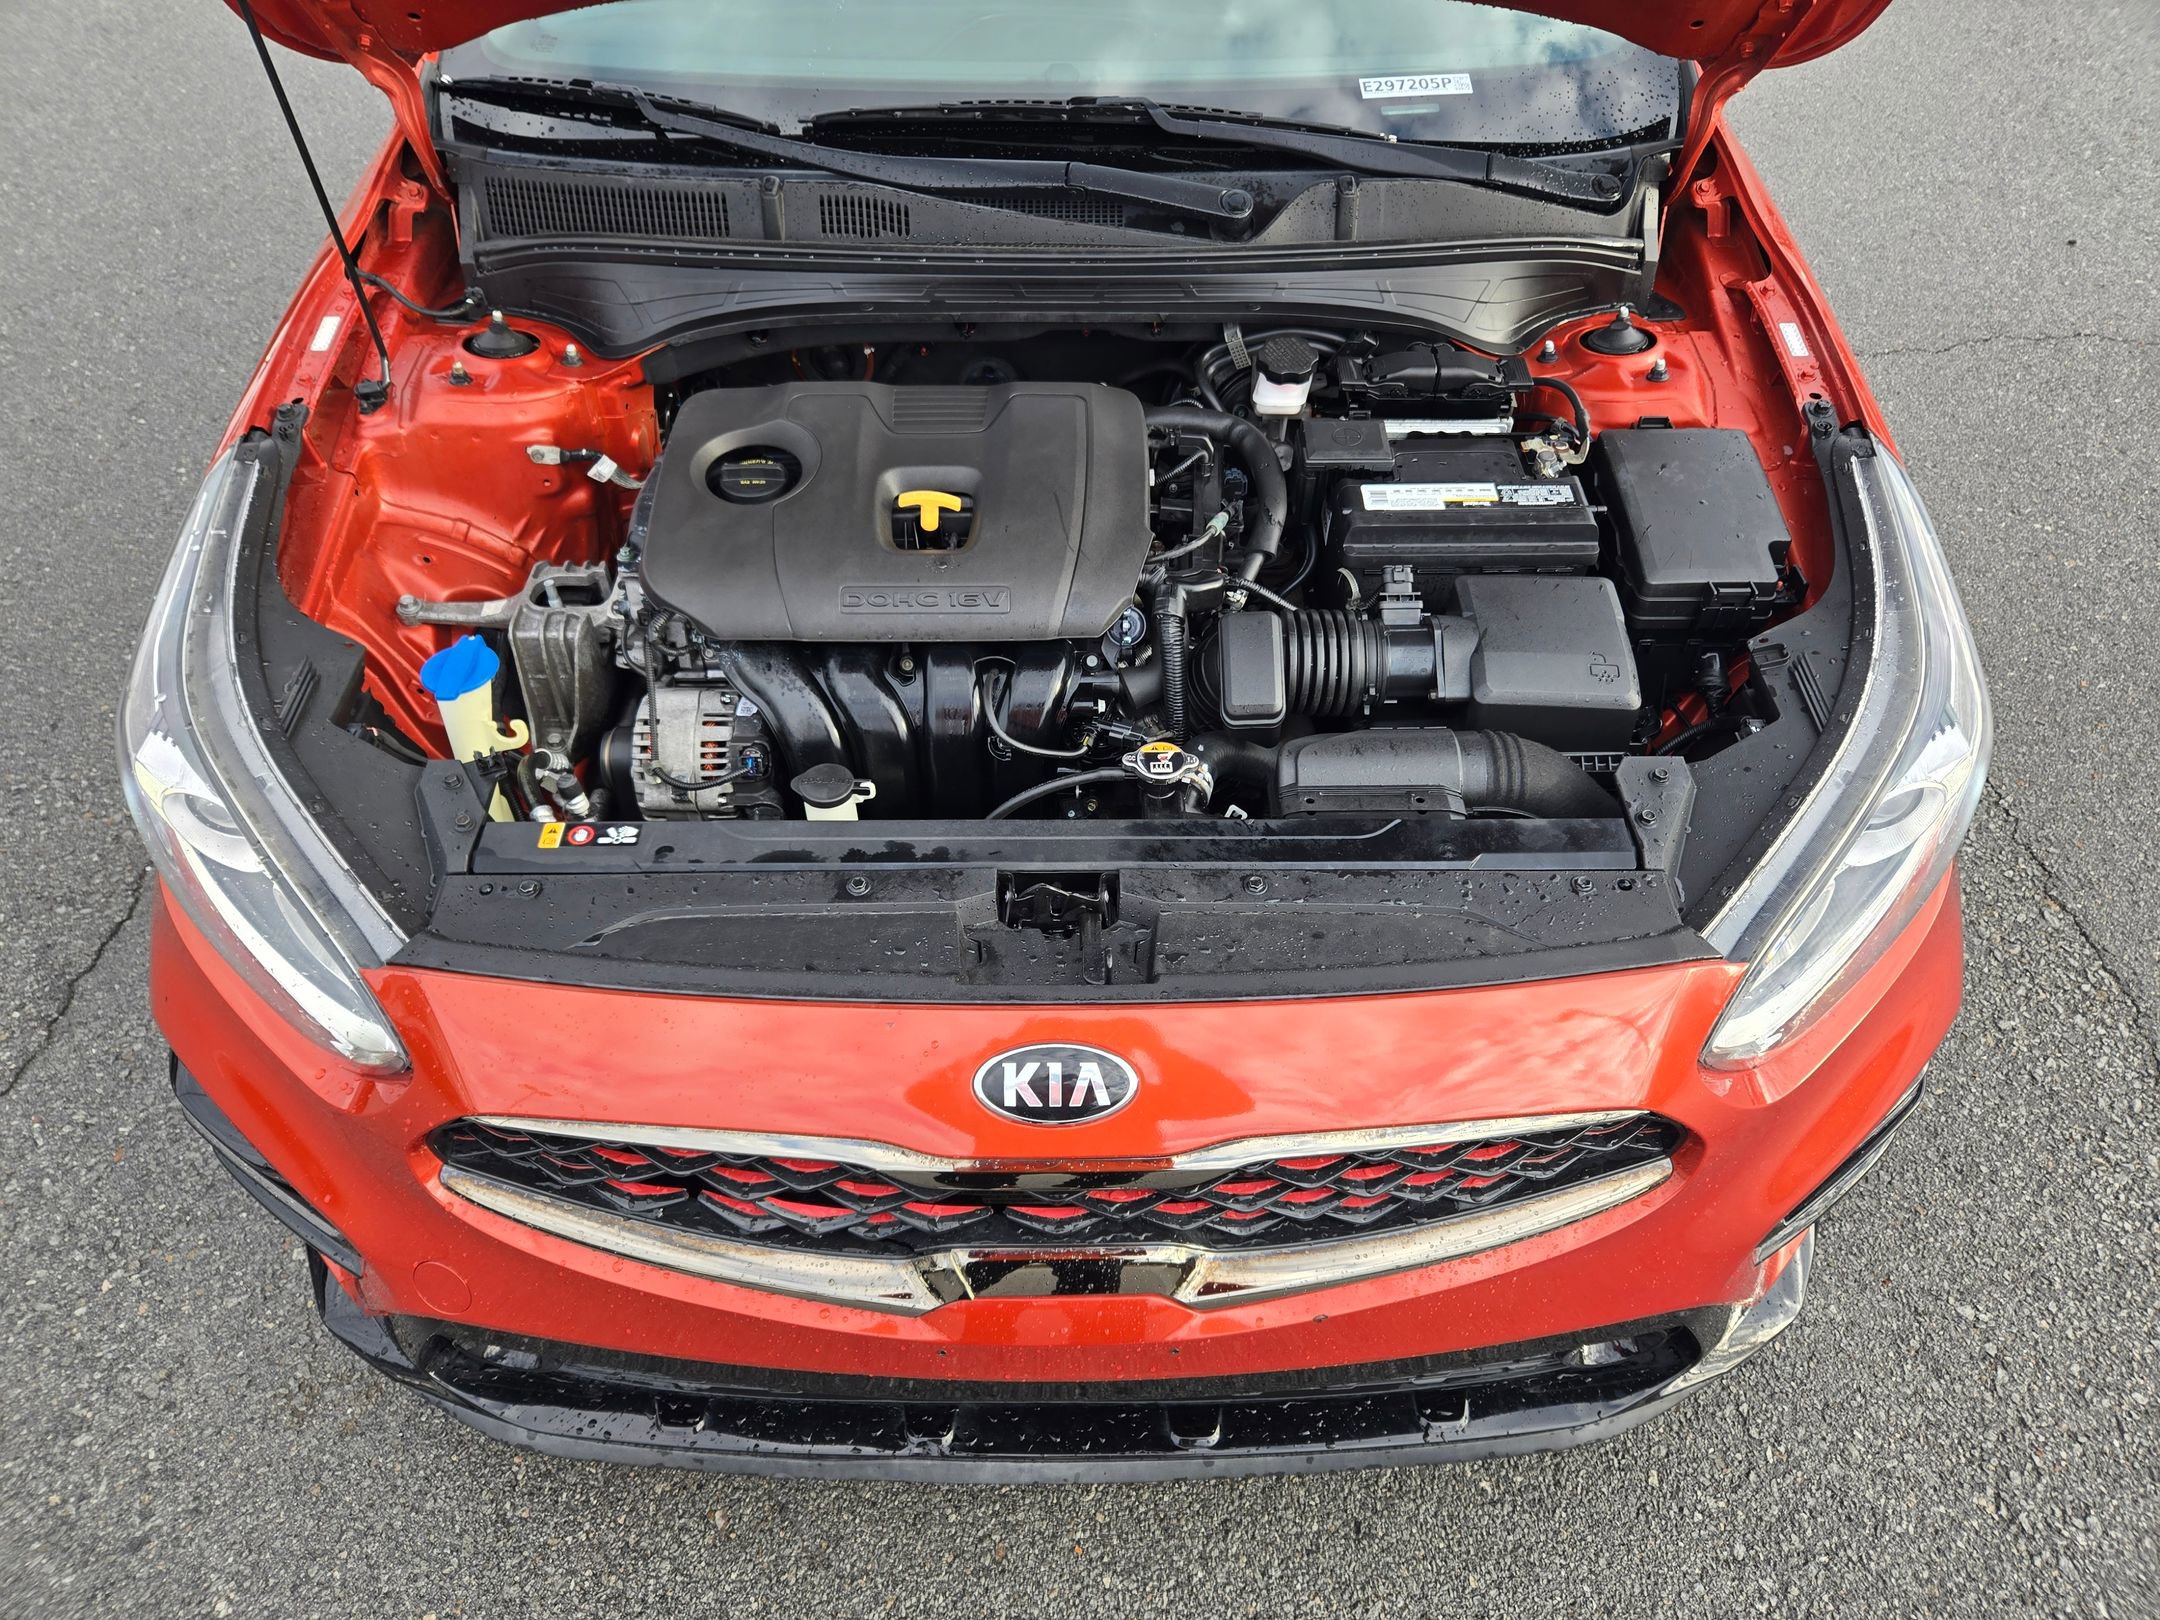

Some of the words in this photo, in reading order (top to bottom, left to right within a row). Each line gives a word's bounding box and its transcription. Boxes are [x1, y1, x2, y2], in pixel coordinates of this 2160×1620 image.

[1362, 77, 1452, 92] E297205P
[842, 591, 939, 607] DOHC
[948, 591, 1007, 607] 16V
[1002, 1062, 1111, 1107] KIA
